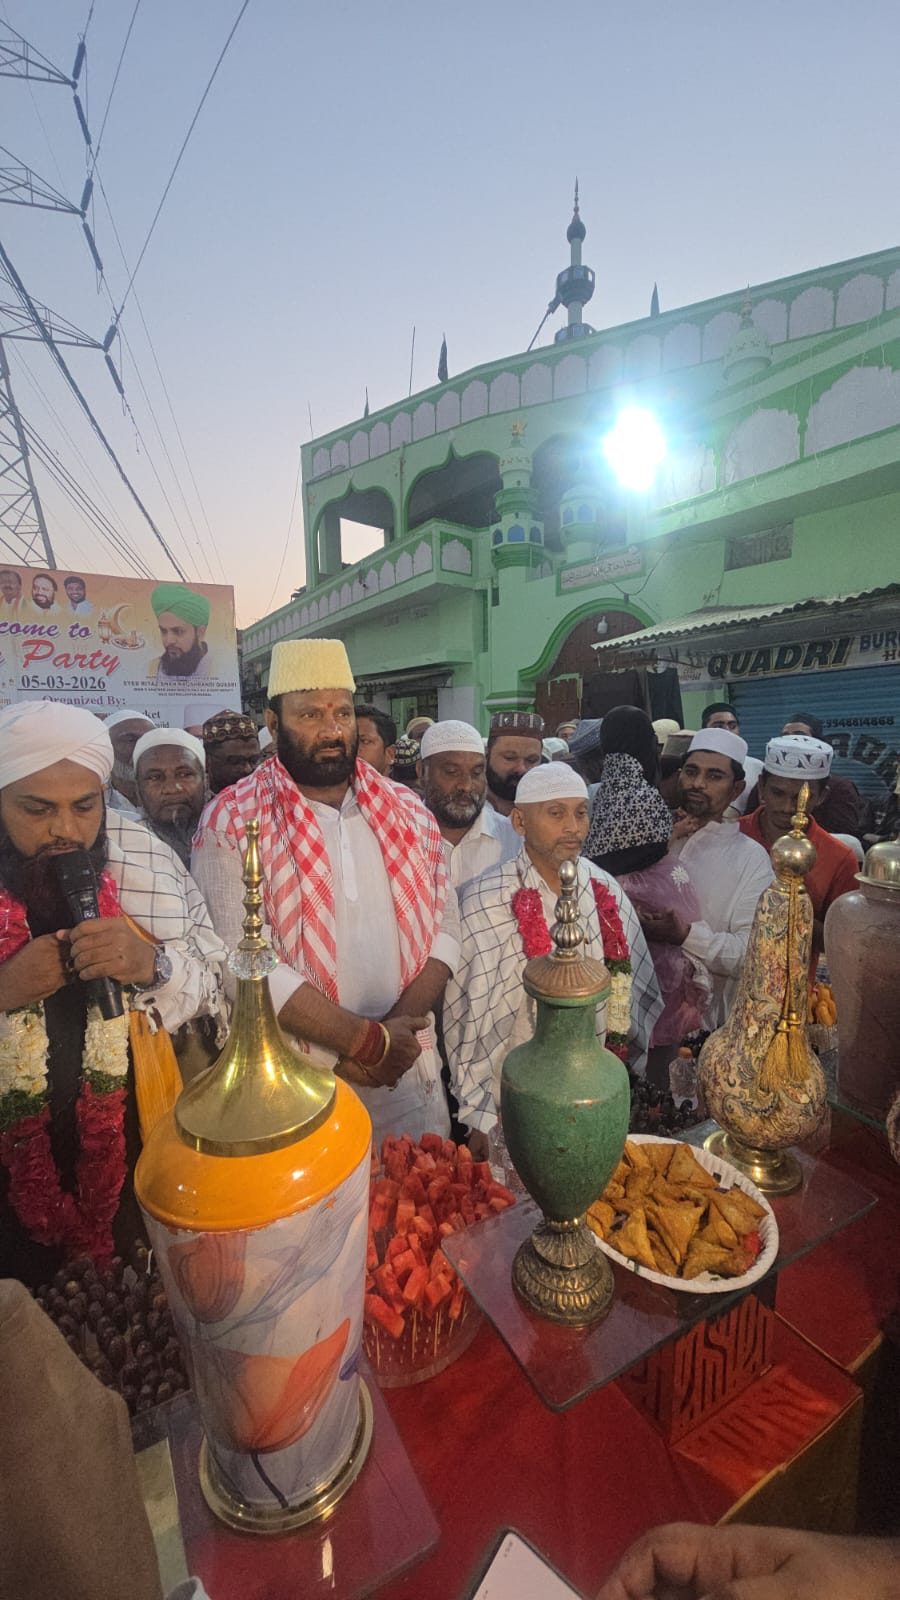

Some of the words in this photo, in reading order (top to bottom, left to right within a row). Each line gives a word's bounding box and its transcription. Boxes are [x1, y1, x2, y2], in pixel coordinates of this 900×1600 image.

[69, 623, 92, 638] to
[22, 639, 119, 676] Party
[708, 637, 855, 678] QUADRI
[860, 631, 900, 653] BUR
[21, 675, 106, 689] 05-03-2026
